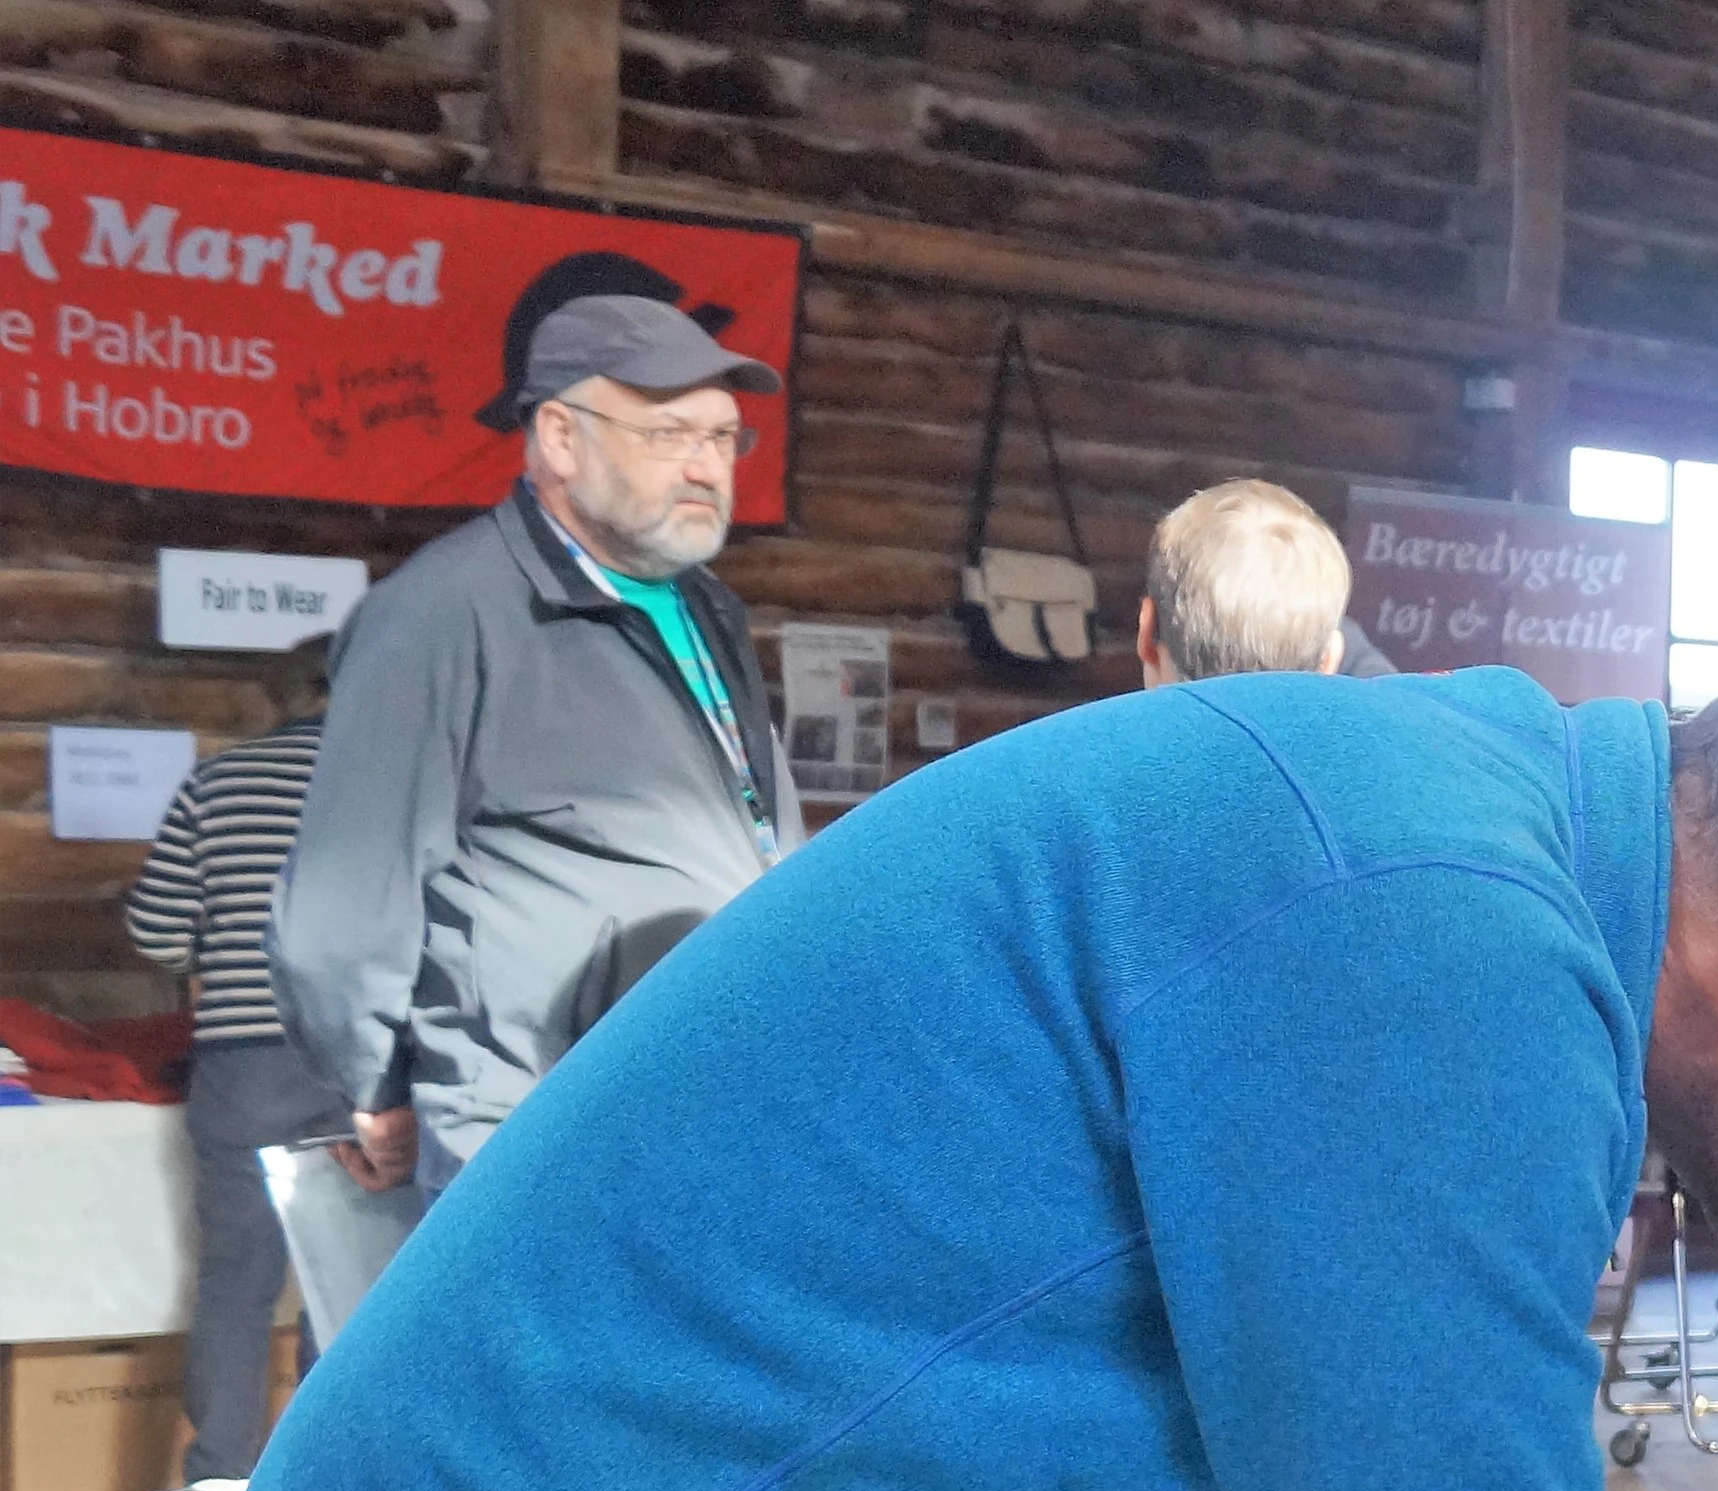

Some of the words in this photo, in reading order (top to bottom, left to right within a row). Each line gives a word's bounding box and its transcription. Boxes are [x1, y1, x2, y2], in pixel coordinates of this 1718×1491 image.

[79, 194, 444, 317] Marked
[57, 304, 278, 381] Pakhus
[25, 372, 41, 428] i
[63, 381, 252, 449] Hobro
[201, 576, 241, 613] Fair
[248, 582, 268, 614] to
[274, 580, 328, 615] Wear
[1363, 521, 1629, 596] Bæredygtigt
[1376, 597, 1436, 651] tøj
[1449, 598, 1489, 640] &
[1502, 605, 1656, 653] textiler
